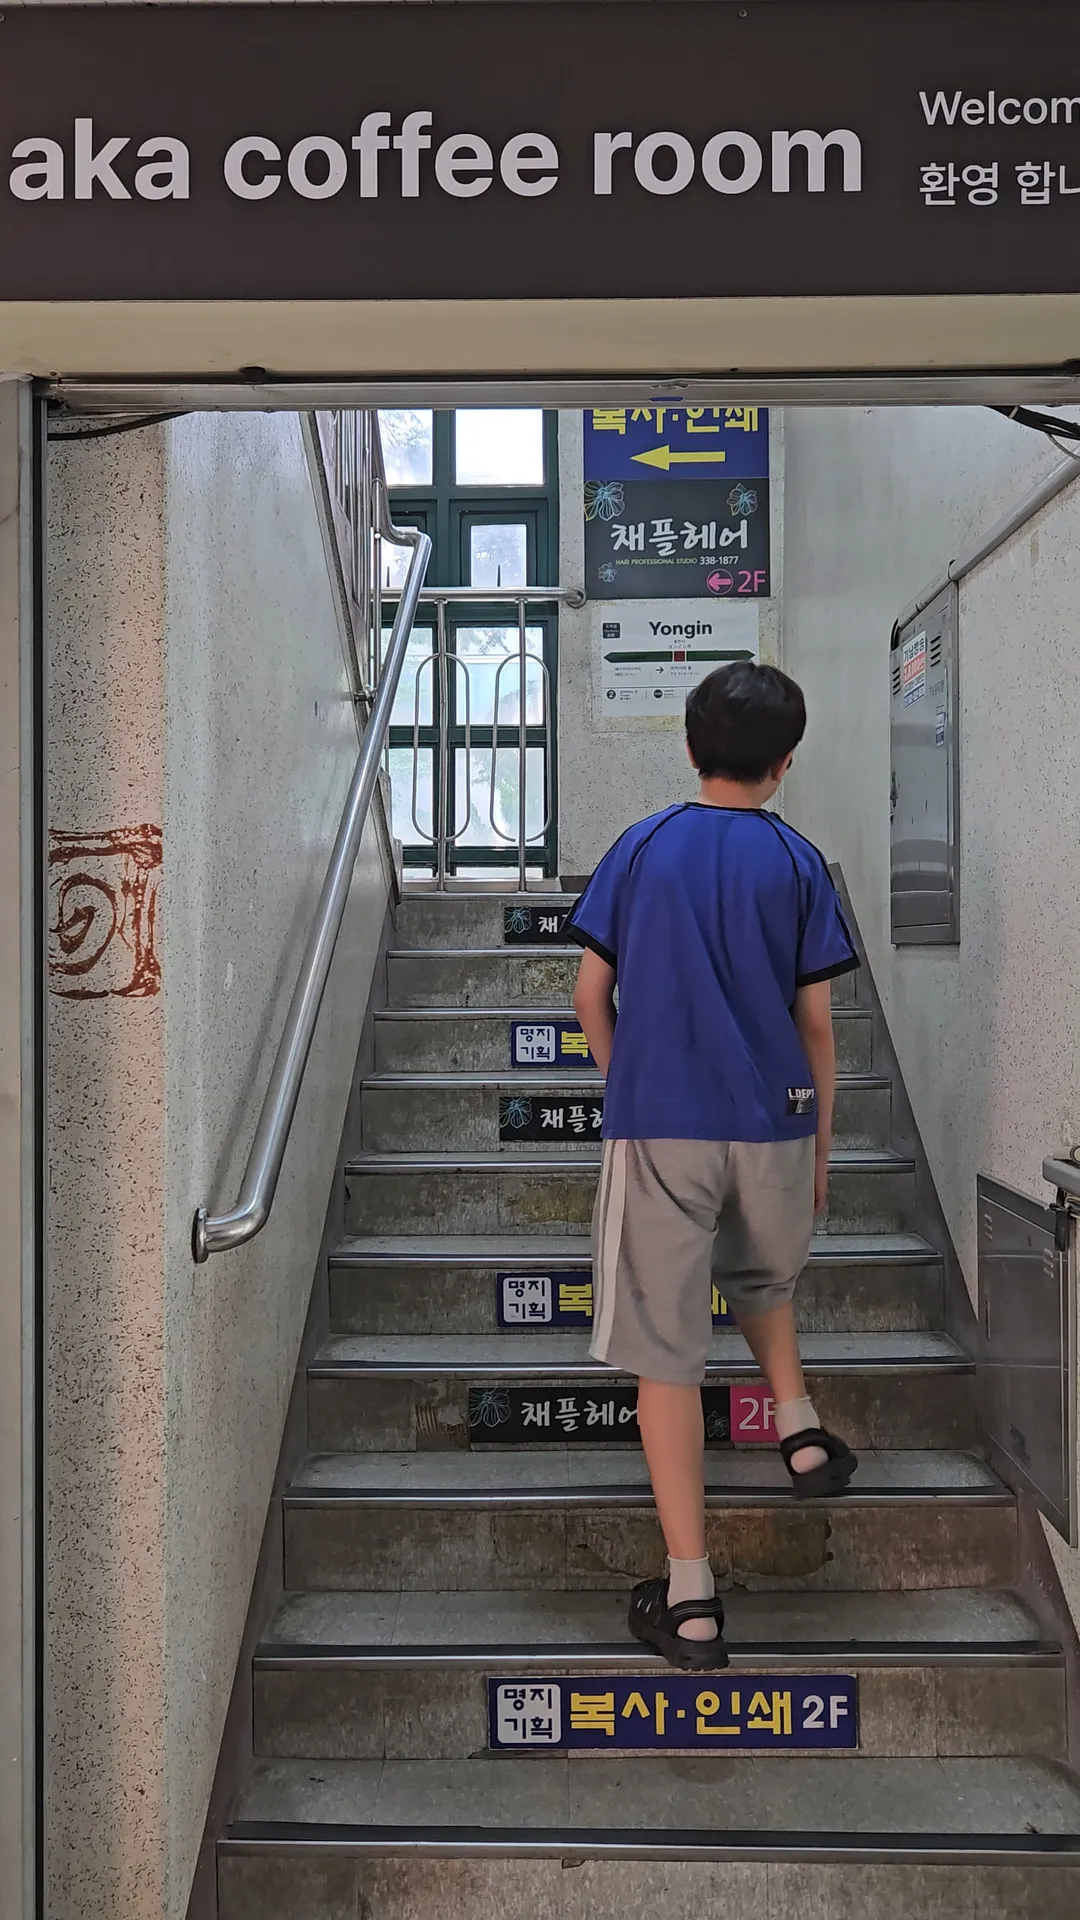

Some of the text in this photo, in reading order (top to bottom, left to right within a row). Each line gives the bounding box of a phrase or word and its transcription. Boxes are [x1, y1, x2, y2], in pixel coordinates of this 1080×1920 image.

[10, 110, 863, 201] aka coffee room
[919, 161, 999, 206] 환영
[610, 518, 748, 557] 채플헤어
[631, 558, 675, 566] PROFESSIONAL
[676, 557, 698, 565] STUDIO
[699, 555, 739, 566] 338-1877
[737, 570, 767, 593] 2F
[648, 620, 713, 640] Yongin
[520, 1028, 550, 1043] 명지
[520, 1045, 550, 1060] 기획
[508, 1280, 546, 1298] 명지
[508, 1301, 546, 1320] 기획
[739, 1397, 776, 1430] 2F
[503, 1688, 553, 1711] 명지
[569, 1690, 849, 1736] 복사·인쇄 2F
[504, 1715, 553, 1740] 기획
